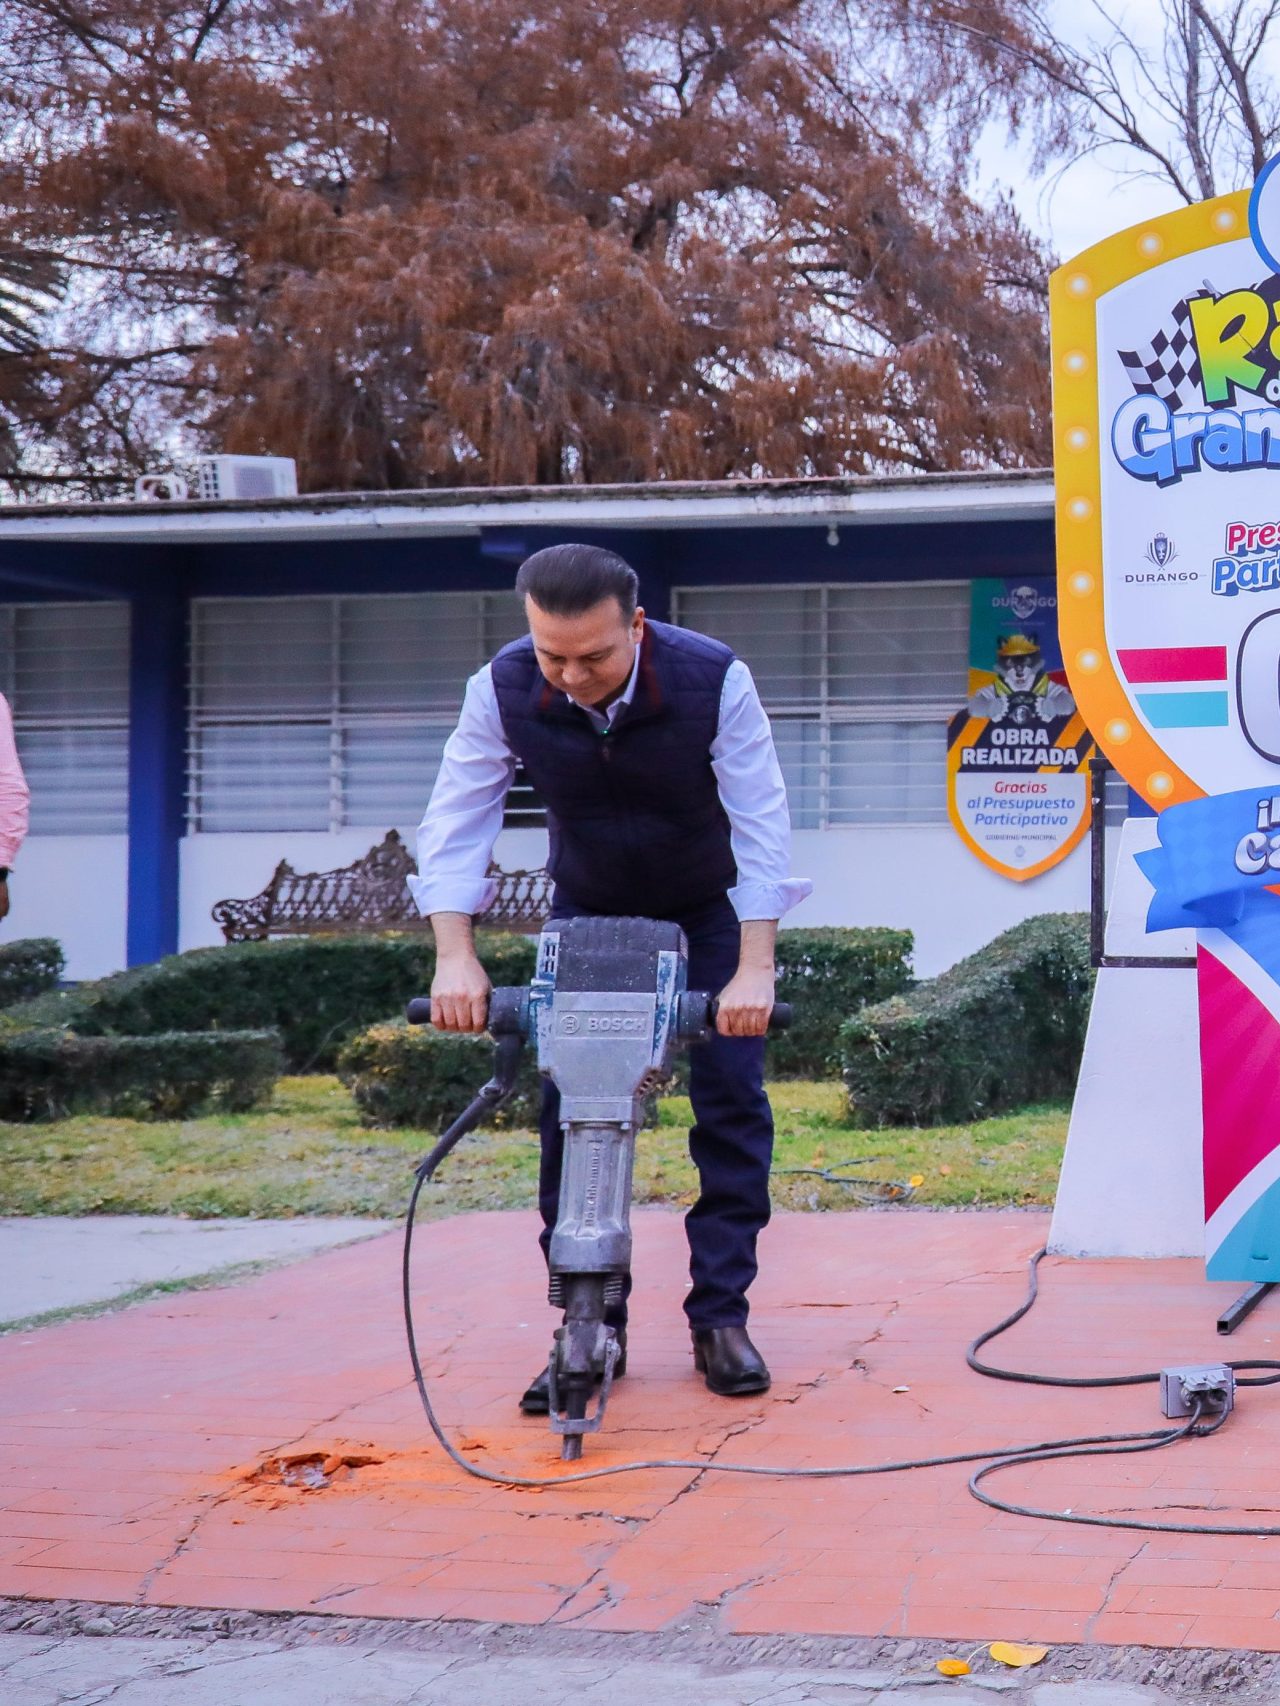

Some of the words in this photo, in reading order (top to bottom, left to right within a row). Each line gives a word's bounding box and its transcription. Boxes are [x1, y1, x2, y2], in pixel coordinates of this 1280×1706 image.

[1125, 572, 1199, 583] DURANGO
[991, 728, 1050, 745] OBRA
[962, 748, 1079, 765] REALIZADA
[994, 780, 1048, 793] Gracias
[967, 797, 981, 809] al
[983, 797, 1076, 811] Presupuesto
[975, 812, 1069, 828] Participativo
[588, 1017, 647, 1031] BOSCH
